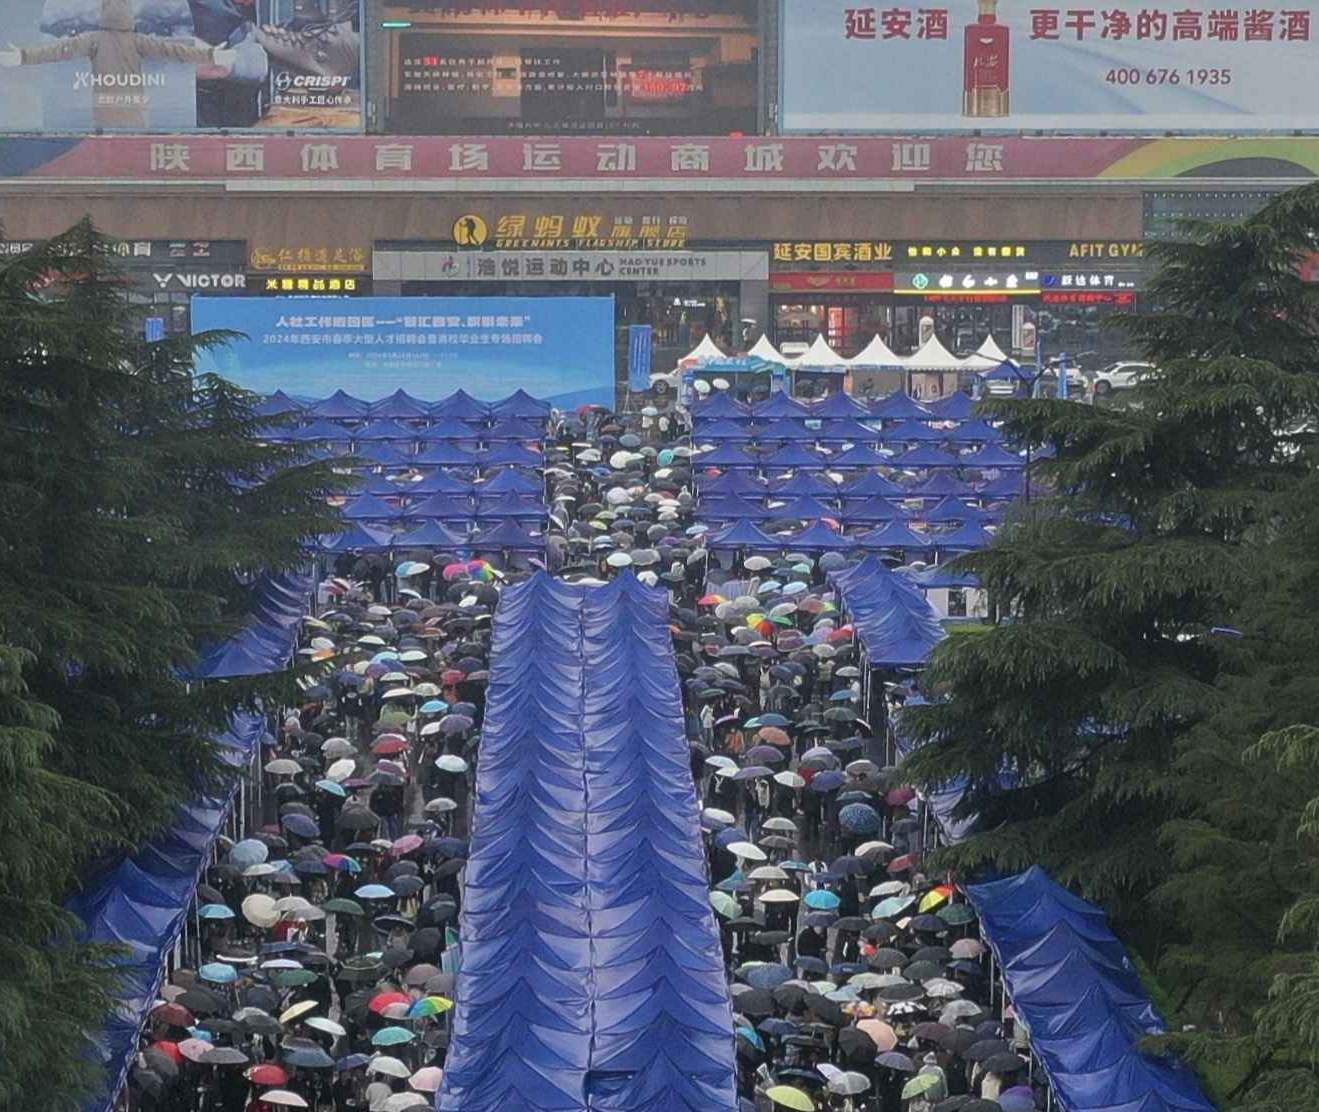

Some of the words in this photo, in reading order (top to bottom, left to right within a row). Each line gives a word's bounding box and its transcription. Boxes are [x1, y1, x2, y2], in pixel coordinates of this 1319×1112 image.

[844, 8, 949, 41] 延安酒
[1029, 8, 1311, 41] 更干净的高端酱酒
[90, 73, 167, 87] HOUDINI
[293, 75, 350, 88] CRISPI
[1105, 68, 1140, 85] 400
[1145, 68, 1180, 85] 676
[1186, 68, 1232, 85] 1935
[149, 142, 1005, 172] 陕西体育场运动商城欢迎您
[494, 215, 603, 238] 绿蚂蚁
[773, 242, 893, 262] 延安国宾酒业
[1069, 243, 1104, 258] AFIT
[477, 257, 616, 277] 浩悦运动中心
[177, 273, 247, 288] VICTOR
